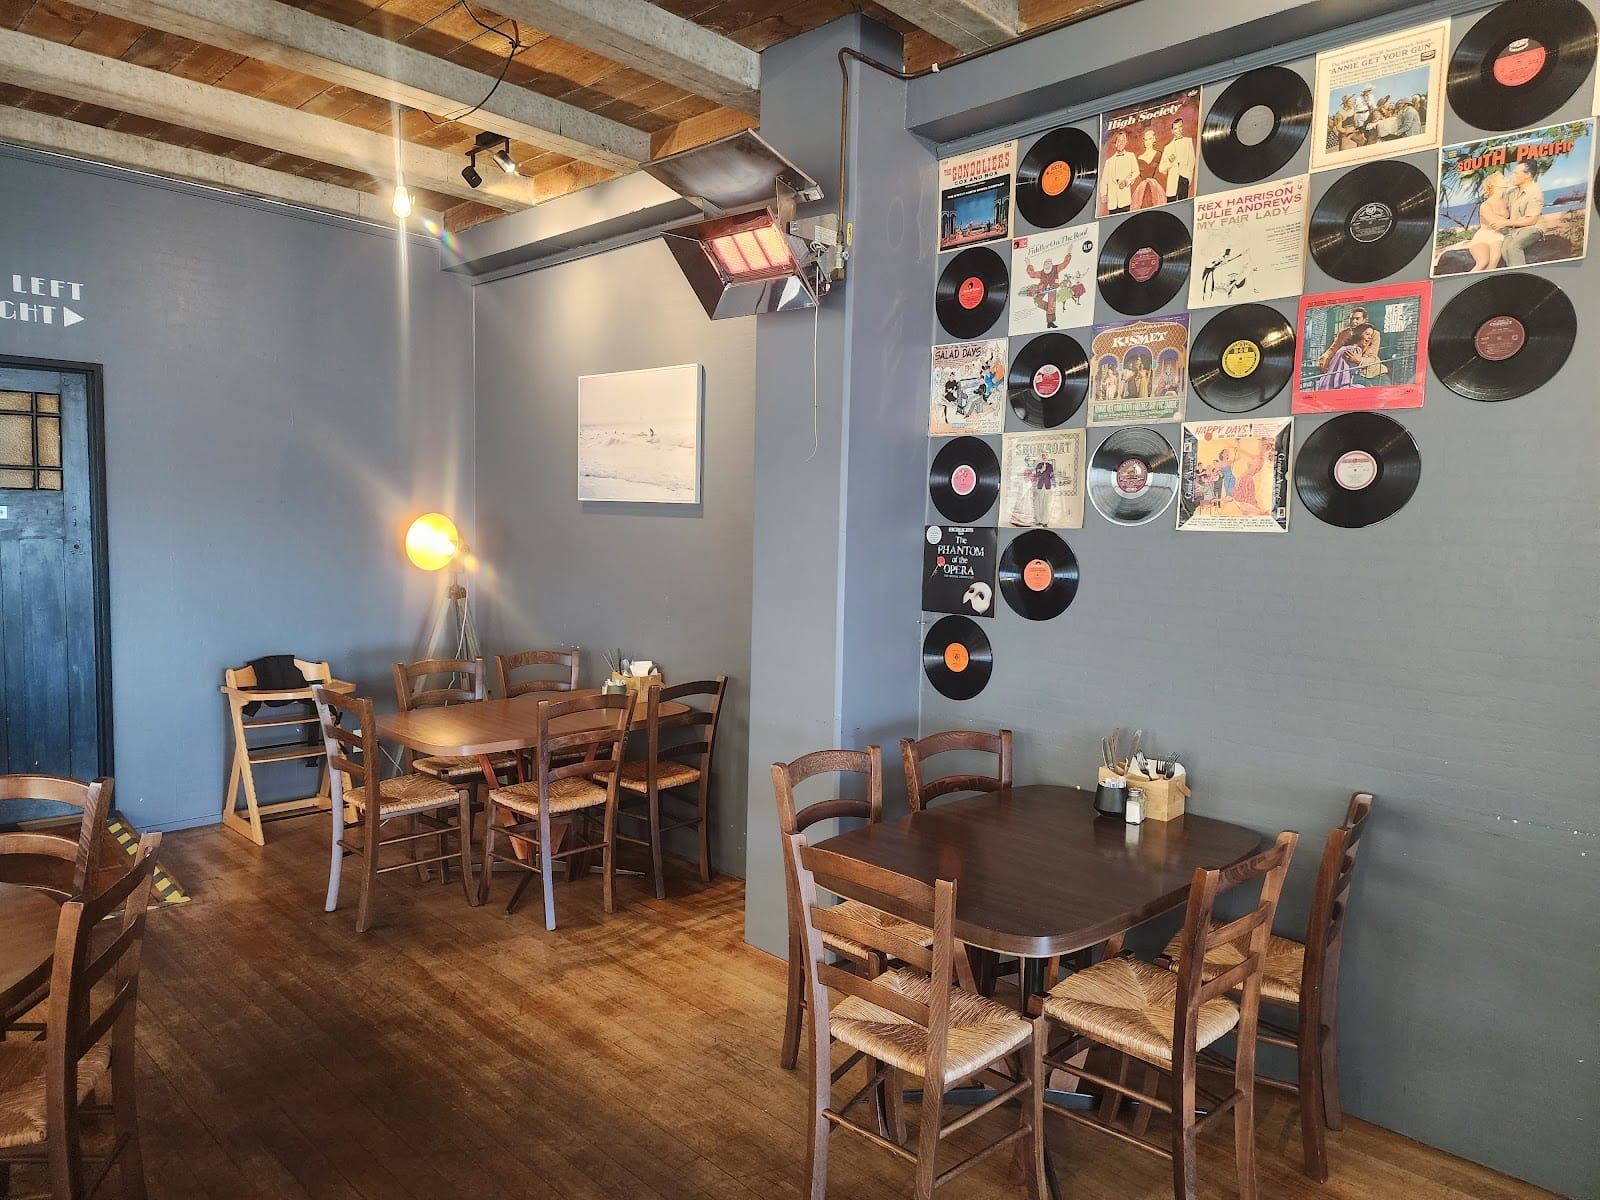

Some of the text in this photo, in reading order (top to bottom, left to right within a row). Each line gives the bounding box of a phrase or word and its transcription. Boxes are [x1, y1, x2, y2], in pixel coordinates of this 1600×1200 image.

[1361, 56, 1380, 66] GET
[1383, 50, 1408, 62] YOUR
[1107, 103, 1183, 131] High Society
[1457, 148, 1506, 172] SOUTH
[1516, 141, 1574, 161] PACIFIC
[952, 151, 1010, 181] GONDOLIERS
[969, 175, 983, 183] AND
[1197, 193, 1302, 221] JULIE ANDREWS
[1198, 186, 1294, 212] REX HARRISON
[1196, 206, 1290, 231] MY FAIR LADY
[12, 274, 84, 300] LEFT
[1112, 331, 1168, 348] KISMET
[935, 349, 960, 361] SALAD
[962, 346, 982, 358] DAYS
[1195, 425, 1223, 435] HAPPY
[956, 536, 968, 544] The
[938, 545, 985, 557] PHANTOM
[951, 556, 969, 564] of the
[943, 564, 975, 576] OPERA
